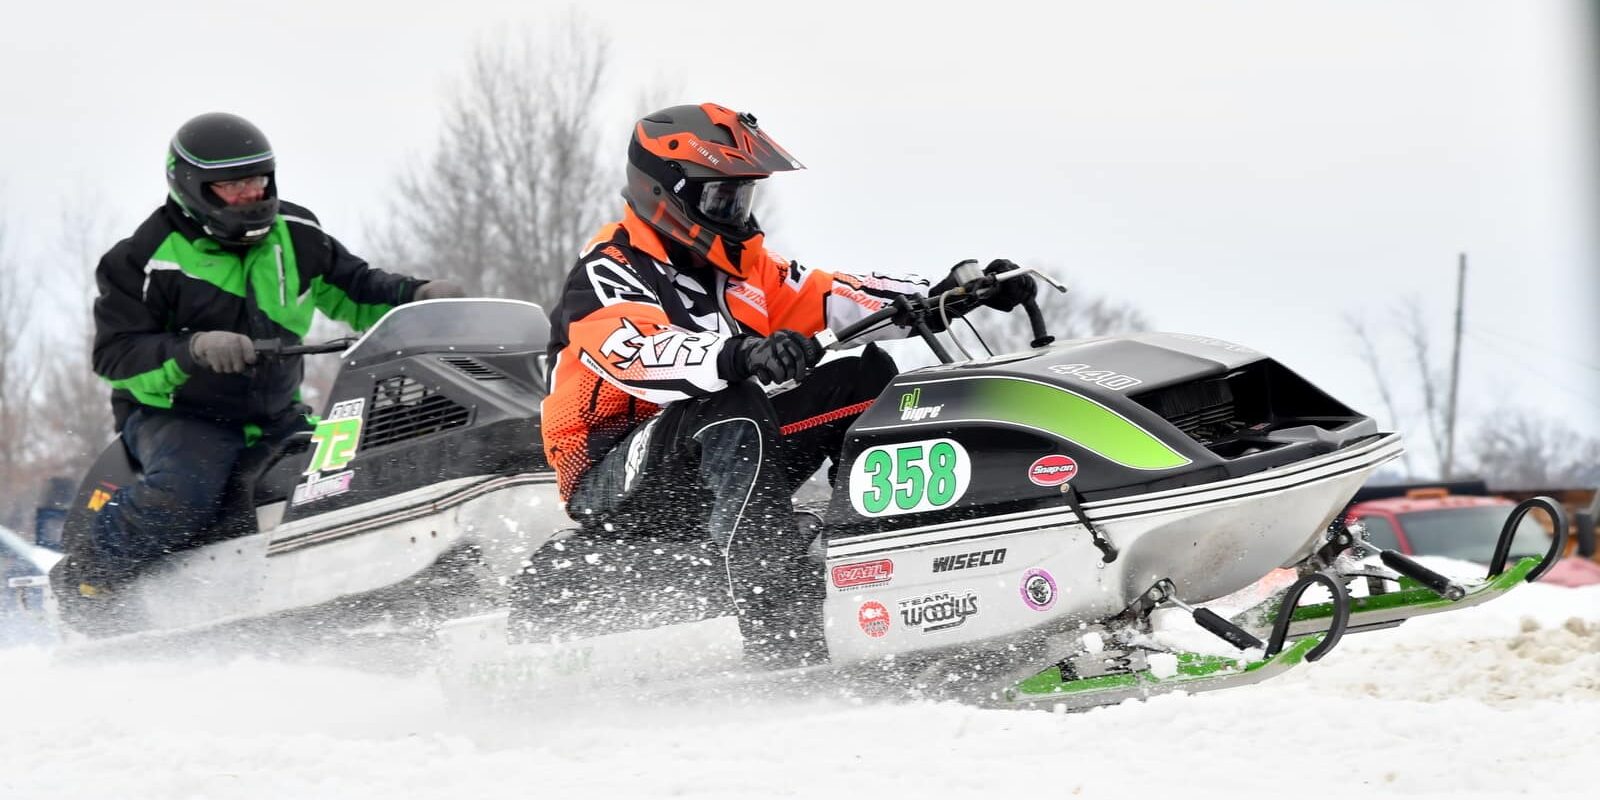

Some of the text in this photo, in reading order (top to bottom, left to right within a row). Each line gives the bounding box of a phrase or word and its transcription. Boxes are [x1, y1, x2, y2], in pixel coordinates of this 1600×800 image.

[599, 317, 721, 370] FXR
[1049, 363, 1143, 391] 440
[899, 388, 920, 411] el
[901, 404, 942, 421] tigre
[302, 418, 363, 476] 72
[863, 442, 957, 514] 358
[1031, 463, 1074, 476] Snap-on
[932, 547, 1007, 573] WISECO
[899, 593, 950, 608] TEAM
